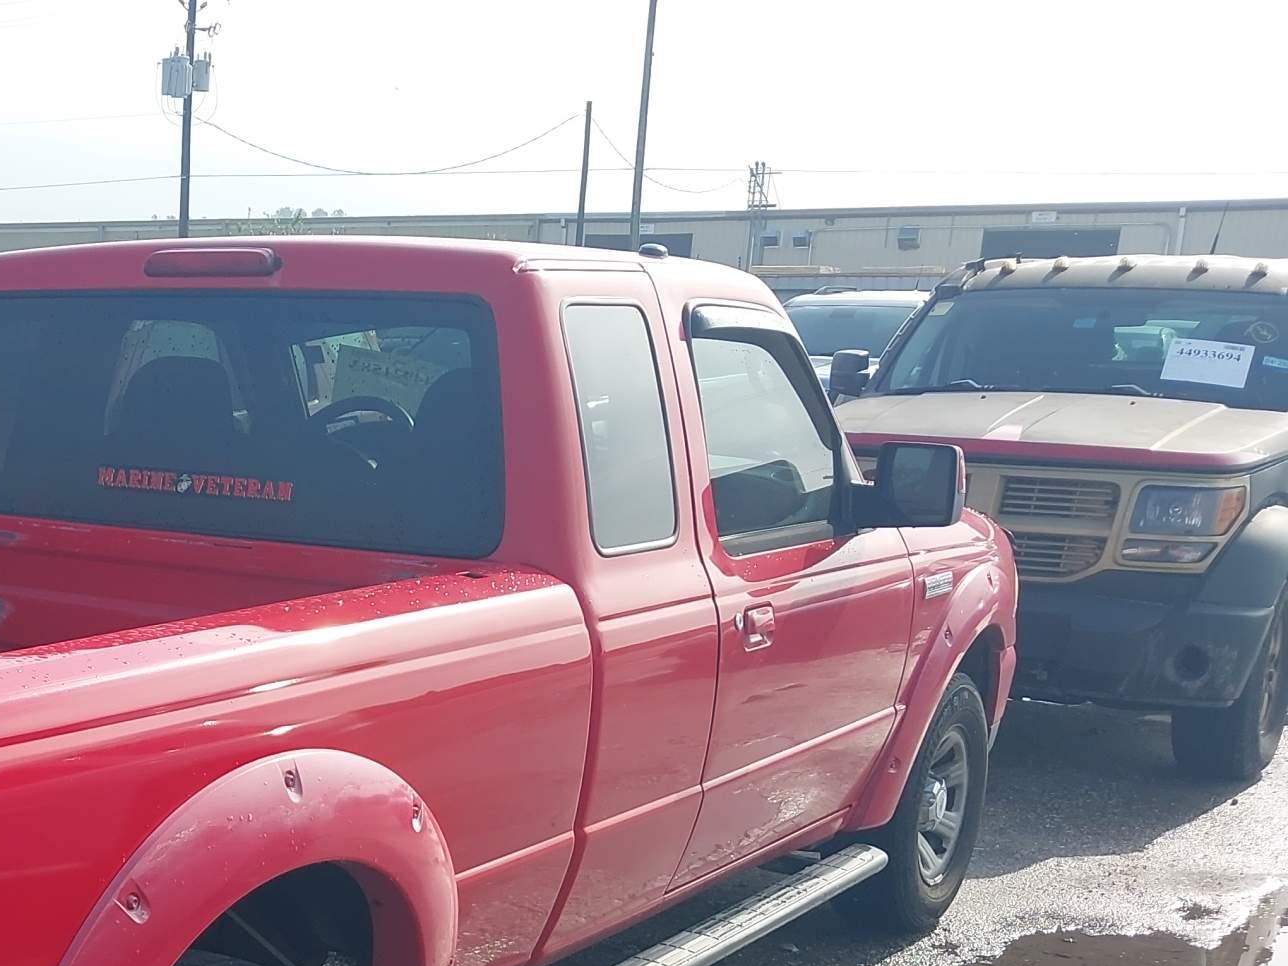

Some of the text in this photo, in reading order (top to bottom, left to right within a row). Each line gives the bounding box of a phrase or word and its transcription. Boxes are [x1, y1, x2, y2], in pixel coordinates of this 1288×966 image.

[1176, 347, 1241, 362] 44933694
[98, 466, 294, 501] MARINE VETERAN
